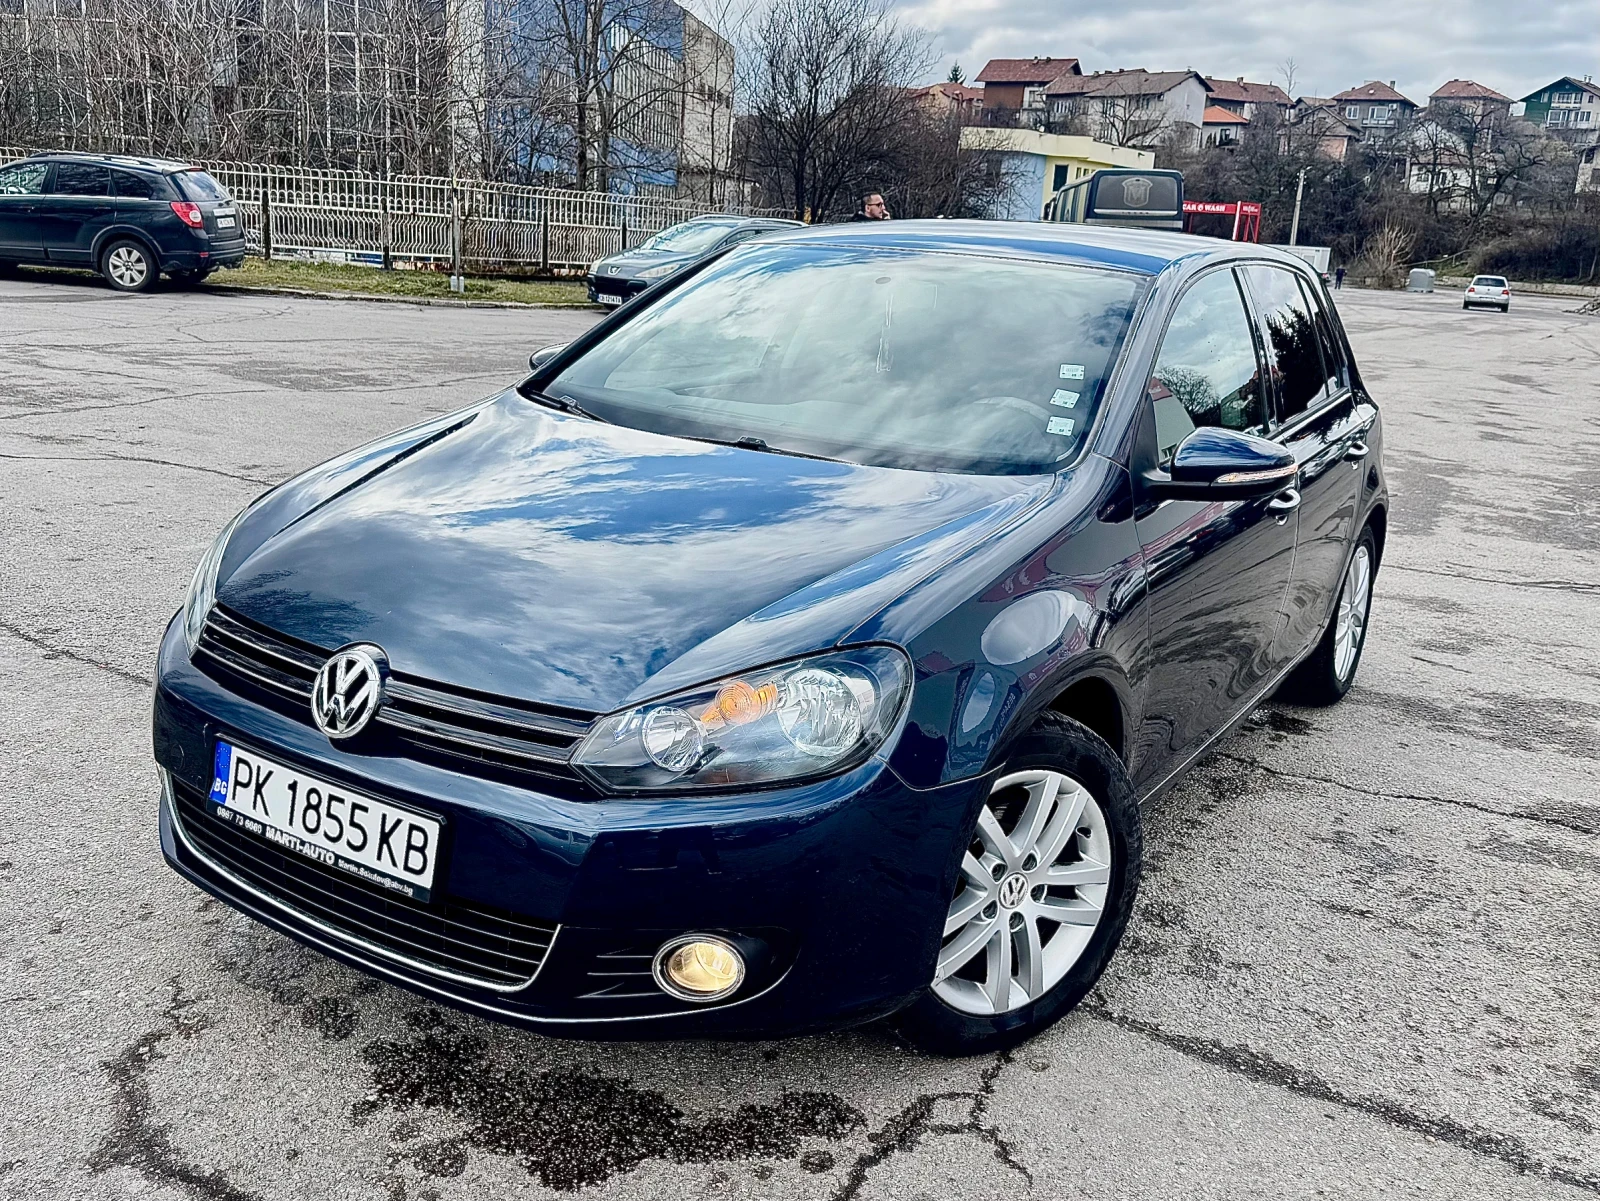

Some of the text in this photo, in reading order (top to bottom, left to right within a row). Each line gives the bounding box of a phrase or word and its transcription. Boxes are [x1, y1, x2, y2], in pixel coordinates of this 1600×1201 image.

[1182, 203, 1226, 212] CAR WASH
[214, 777, 228, 795] BG
[231, 756, 429, 876] PK 1855 KB
[235, 814, 244, 826] 73
[265, 825, 336, 865] MARTI-AUTO
